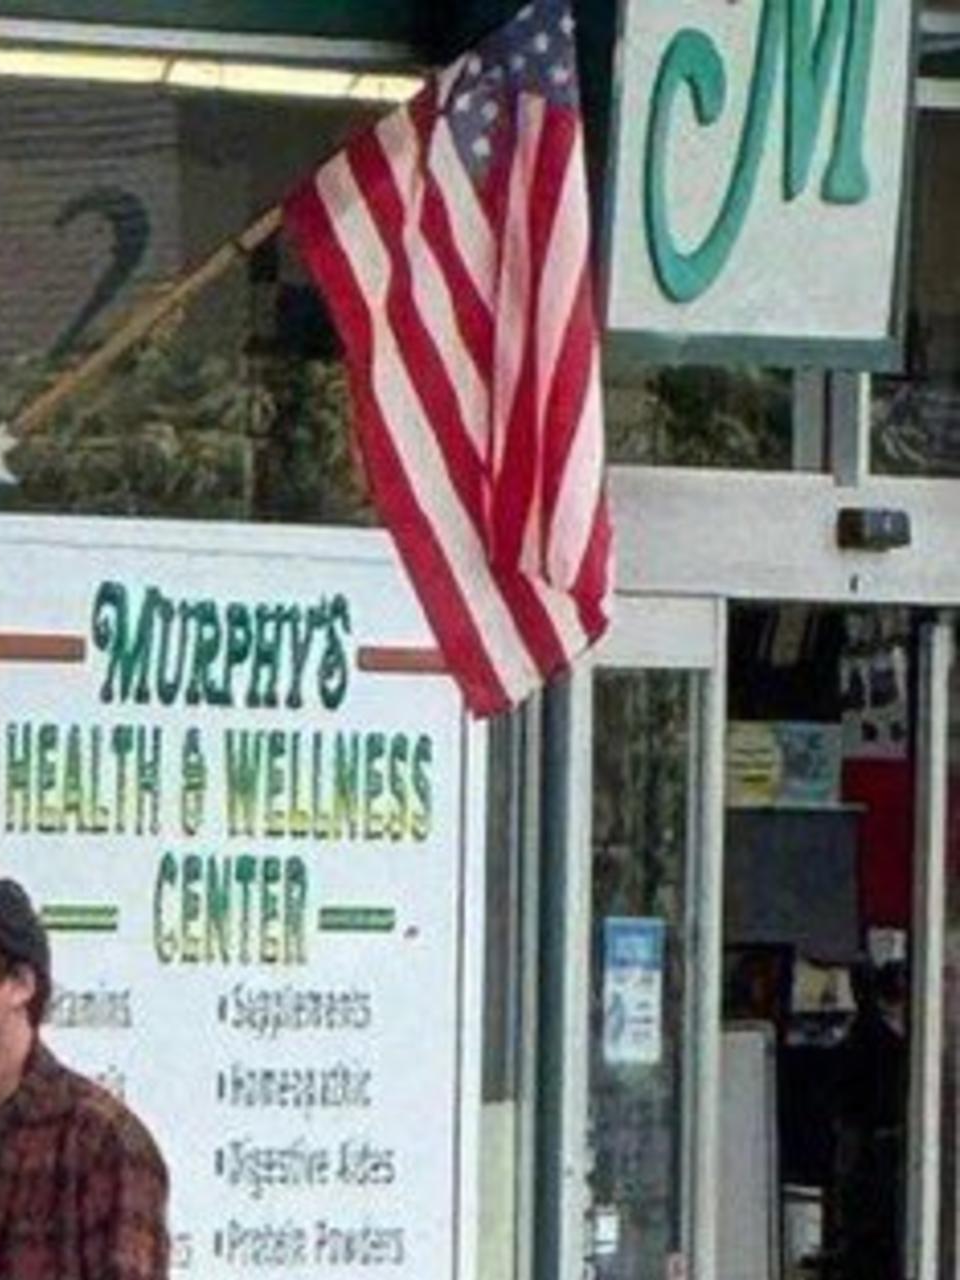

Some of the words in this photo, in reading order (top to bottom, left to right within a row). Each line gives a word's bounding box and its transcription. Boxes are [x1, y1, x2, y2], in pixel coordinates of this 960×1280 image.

[92, 580, 352, 709] MURPHY'S
[5, 721, 162, 835] HEALTH
[182, 726, 208, 837] &
[224, 727, 433, 842] WELLNESS
[152, 851, 309, 965] CENTER
[230, 983, 372, 1040] Supplements
[227, 1137, 329, 1200] Digestive
